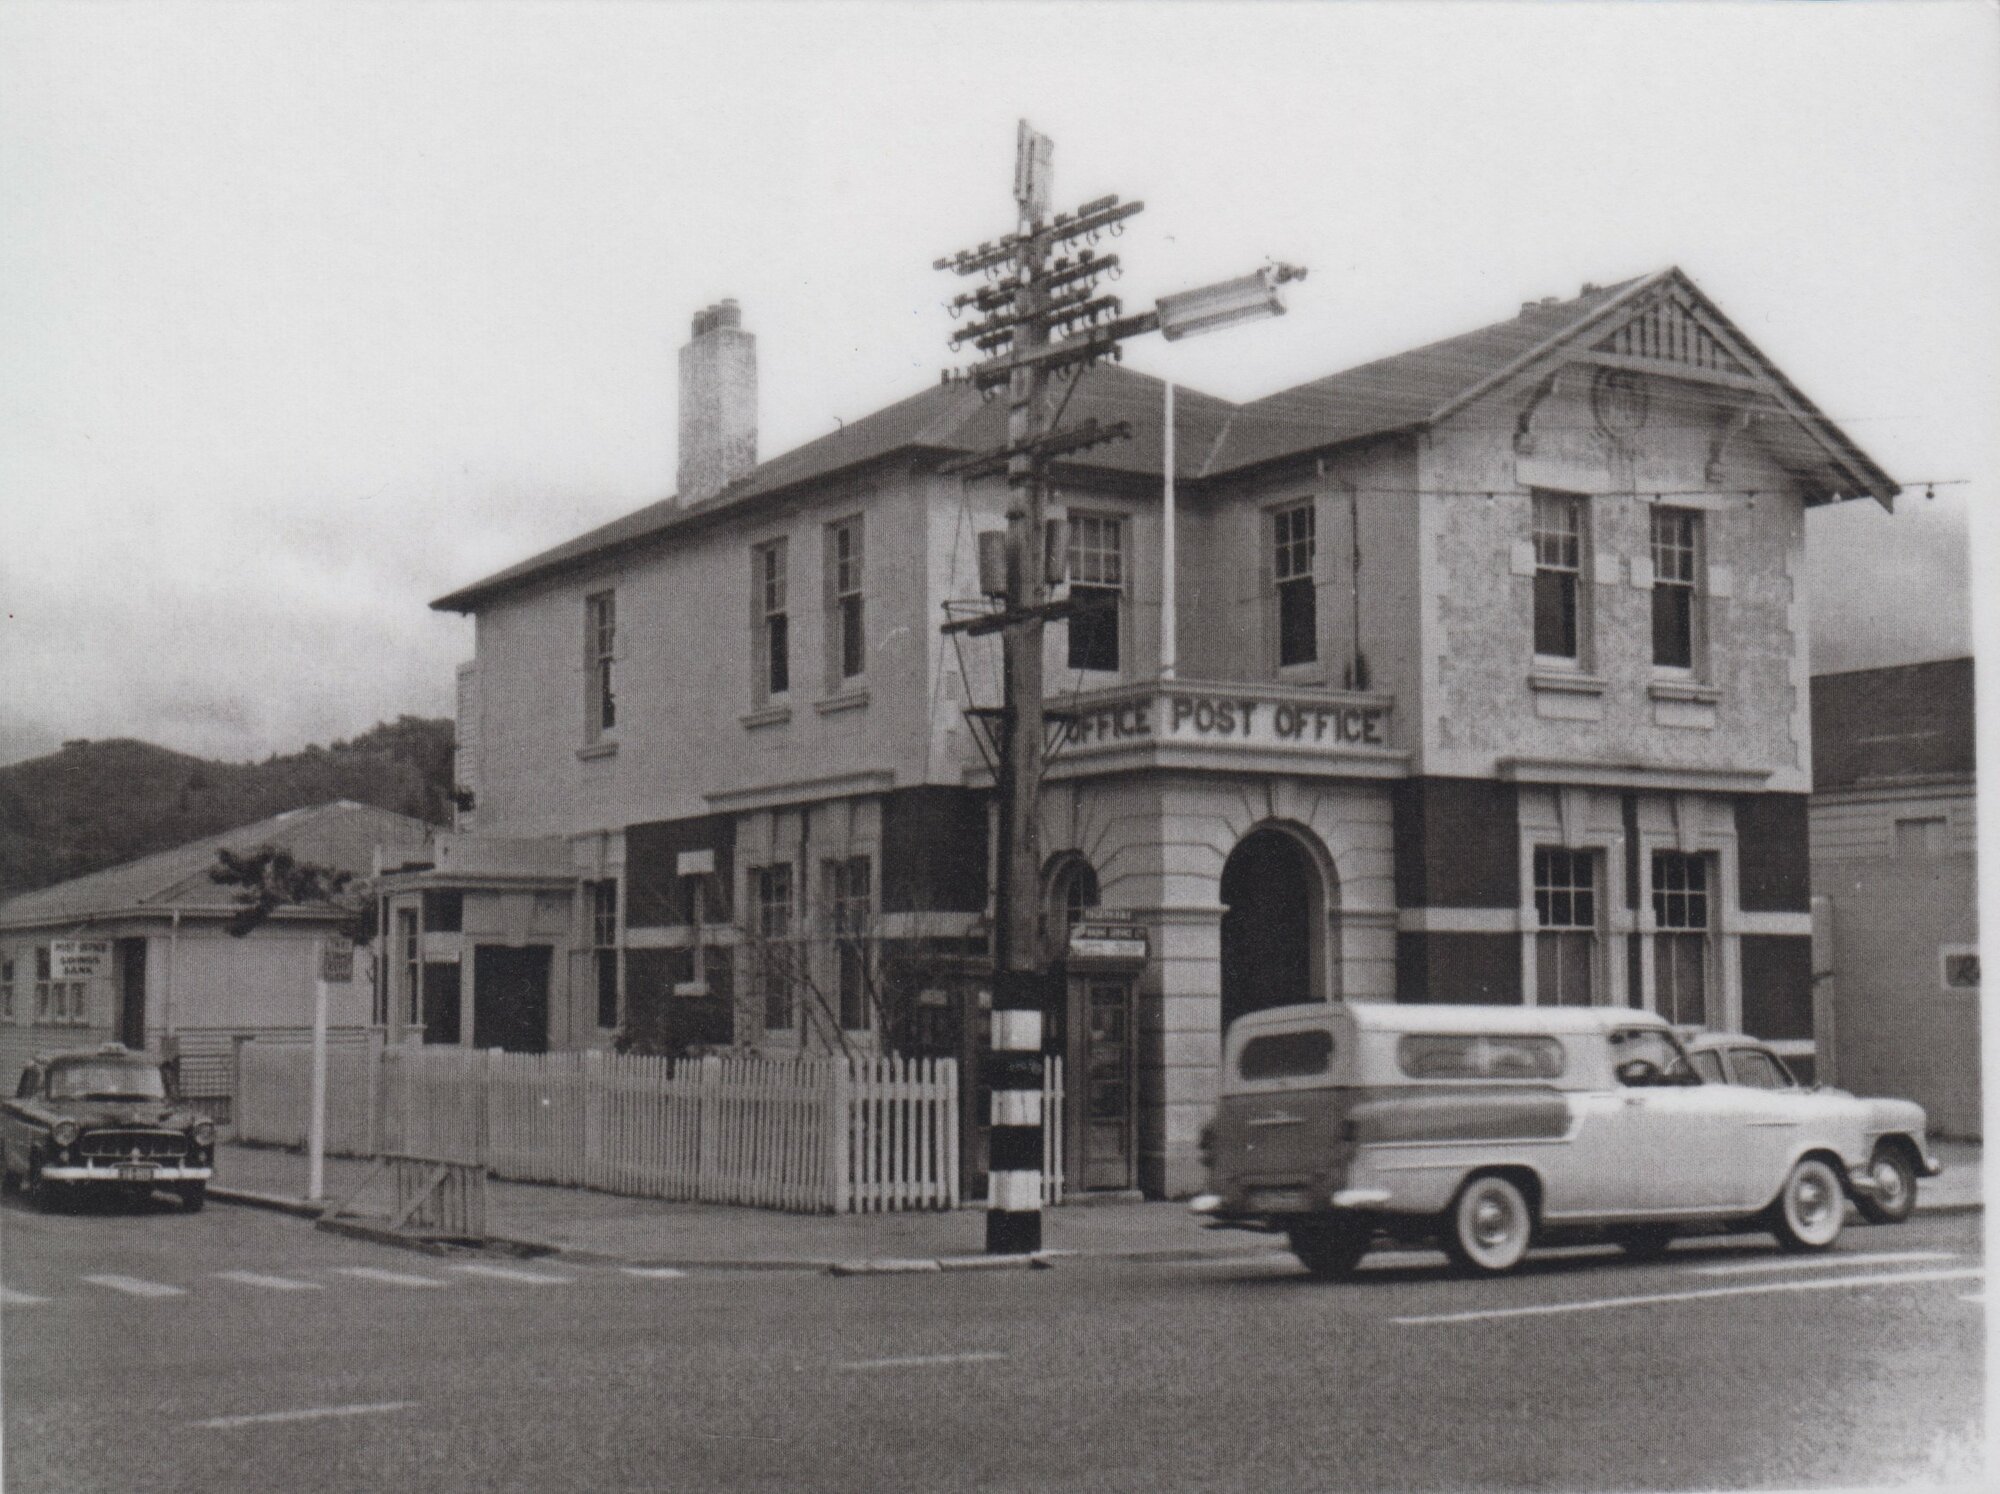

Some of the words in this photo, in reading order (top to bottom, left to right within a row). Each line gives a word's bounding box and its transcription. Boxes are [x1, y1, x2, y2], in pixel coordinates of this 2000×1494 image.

[1065, 697, 1152, 744] OFFICE
[1171, 699, 1257, 738] POST
[1273, 704, 1383, 744] OFFICE
[64, 966, 94, 976] BANK
